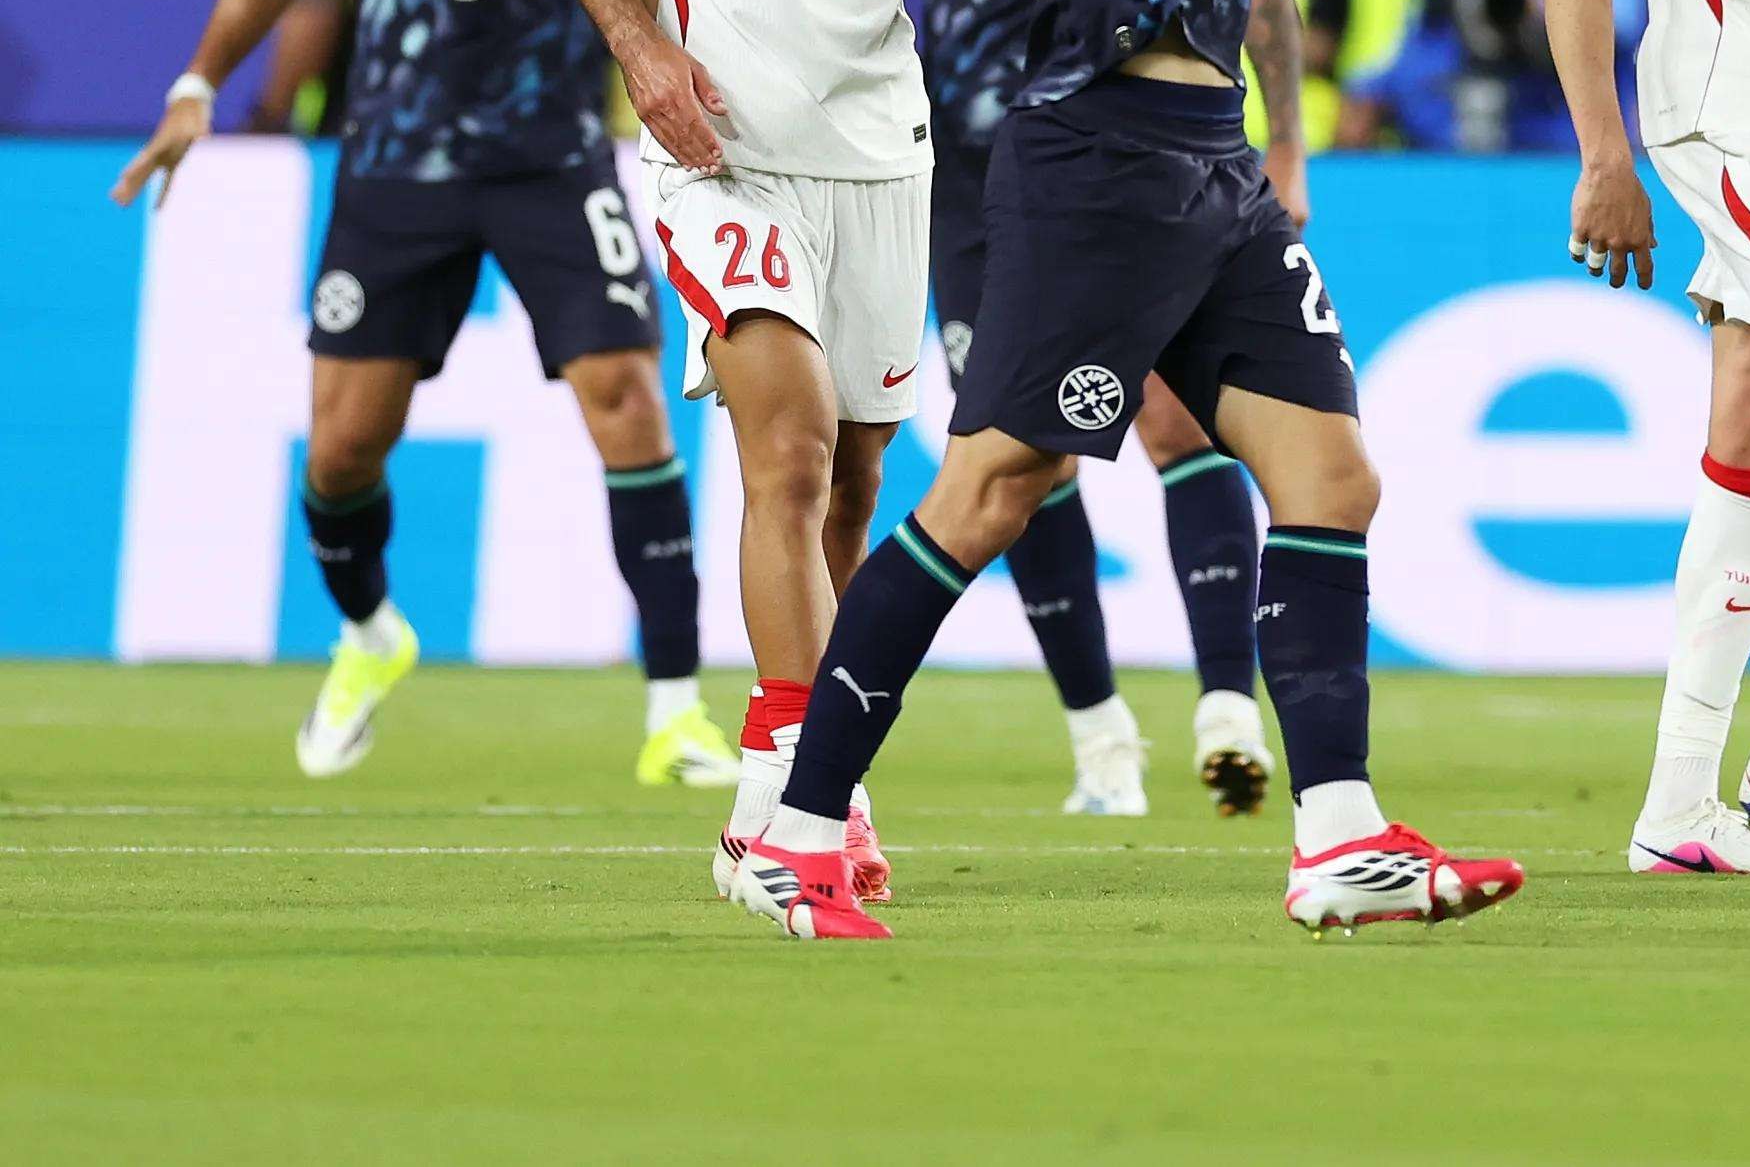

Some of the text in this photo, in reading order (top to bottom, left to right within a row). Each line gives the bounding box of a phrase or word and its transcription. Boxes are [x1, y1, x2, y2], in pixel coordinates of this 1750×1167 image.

[584, 187, 641, 277] 6
[715, 222, 793, 292] 26
[1283, 242, 1341, 334] 2
